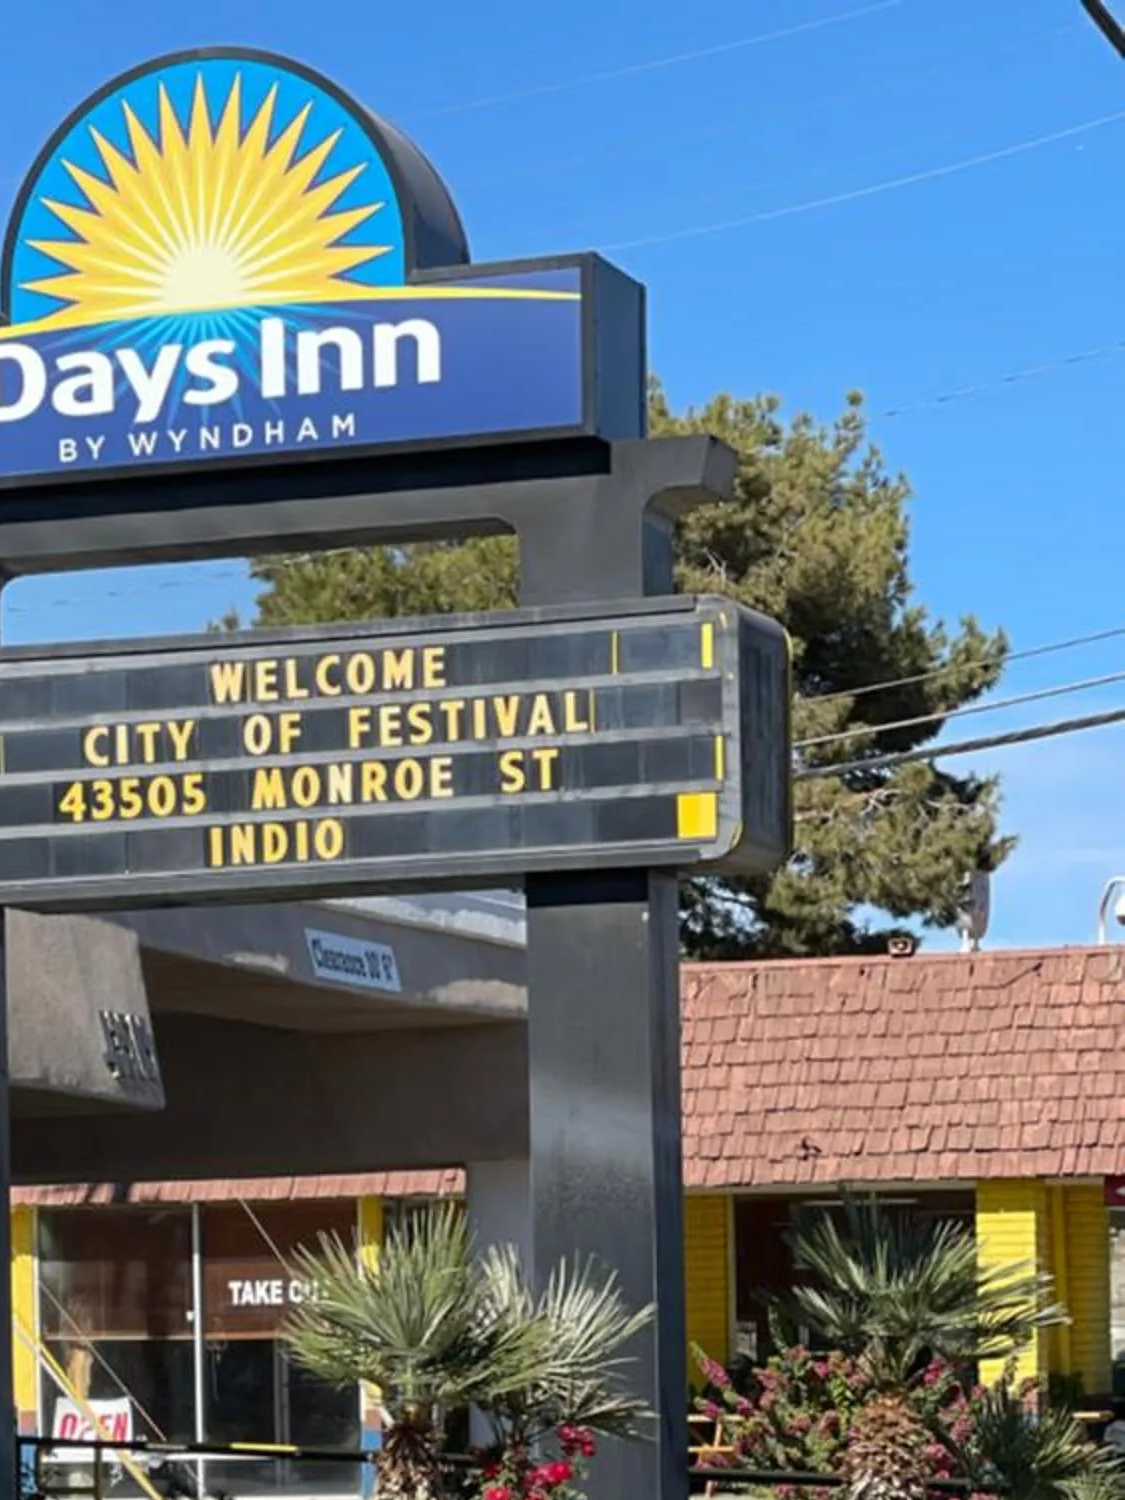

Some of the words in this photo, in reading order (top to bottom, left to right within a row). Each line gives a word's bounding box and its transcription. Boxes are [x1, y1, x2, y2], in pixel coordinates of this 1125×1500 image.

[261, 317, 441, 399] Inn
[58, 434, 103, 463] BY
[130, 414, 357, 458] WYNDHAM
[210, 647, 446, 704] WELCOME
[83, 720, 196, 767] CITY
[243, 714, 303, 757] OF
[348, 690, 589, 749] FESTIVAL
[58, 773, 207, 822] 43505
[252, 756, 453, 810] MONROE
[500, 748, 560, 794] ST
[210, 820, 345, 867] INDIO
[228, 1280, 283, 1305] TAKE
